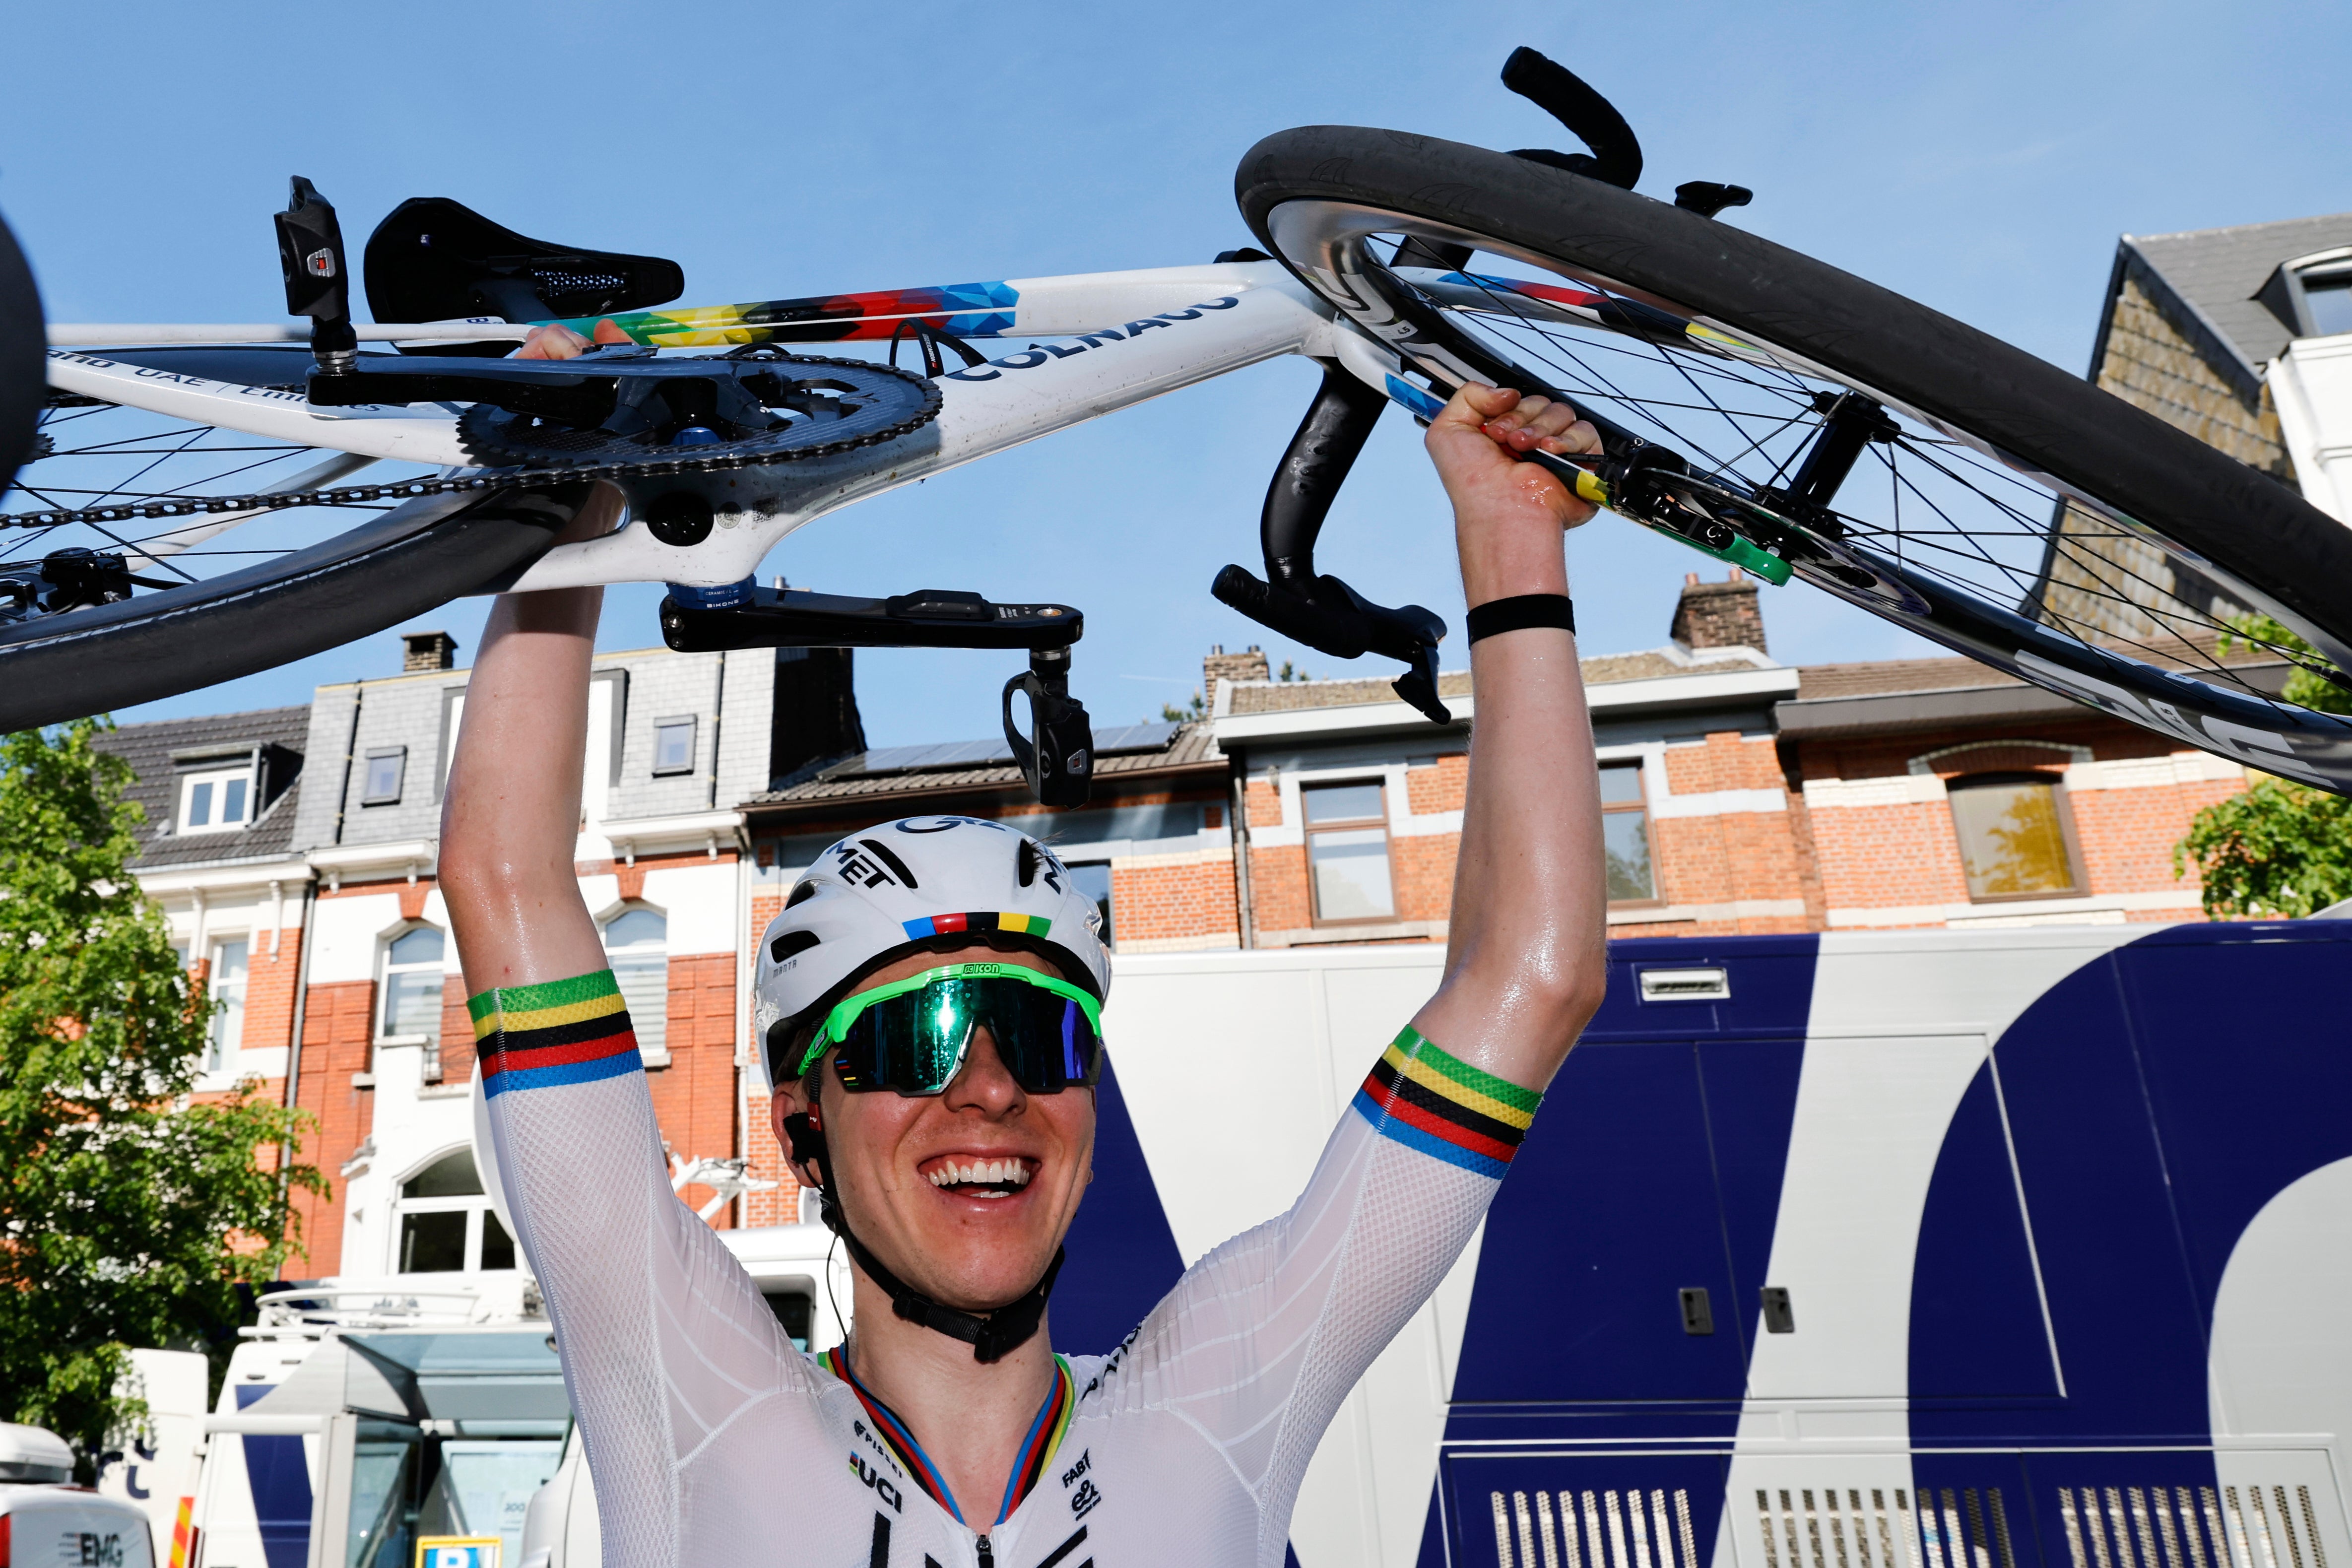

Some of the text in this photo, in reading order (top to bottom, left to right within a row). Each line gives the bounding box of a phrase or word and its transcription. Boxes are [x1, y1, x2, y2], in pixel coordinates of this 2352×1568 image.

[944, 297, 1239, 381] COLNAGO
[134, 368, 211, 386] UAE
[707, 599, 739, 608] BIKONE
[826, 841, 896, 889] MET
[773, 959, 797, 979] MANTA
[858, 1457, 902, 1514] UCI
